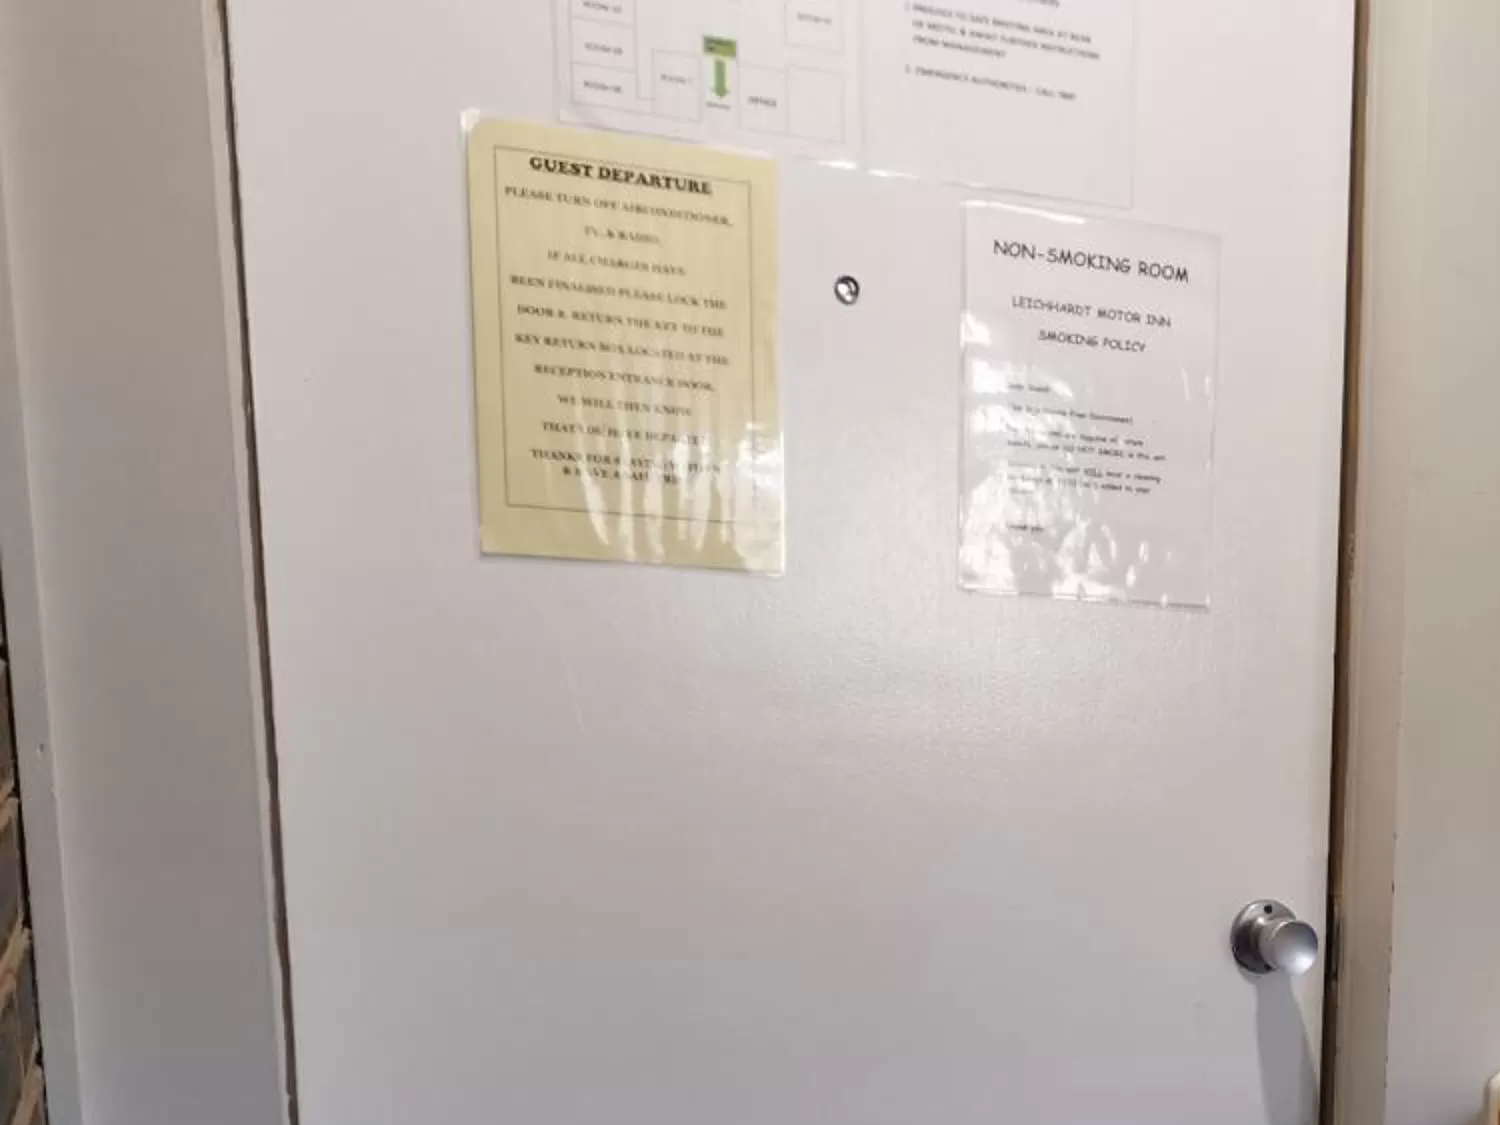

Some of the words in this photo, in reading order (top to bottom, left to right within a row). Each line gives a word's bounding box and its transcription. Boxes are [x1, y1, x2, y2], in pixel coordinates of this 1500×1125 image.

[529, 157, 594, 178] GUEST
[598, 166, 712, 195] DEPARTURE
[993, 240, 1130, 274] NON-SMOKING
[1137, 260, 1188, 284] ROOM
[1012, 295, 1090, 317] LEICHHARDT
[1097, 306, 1140, 323] MOTOR
[1145, 312, 1171, 327] INN
[1038, 329, 1097, 346] SMOKING
[1103, 336, 1146, 352] POLICY
